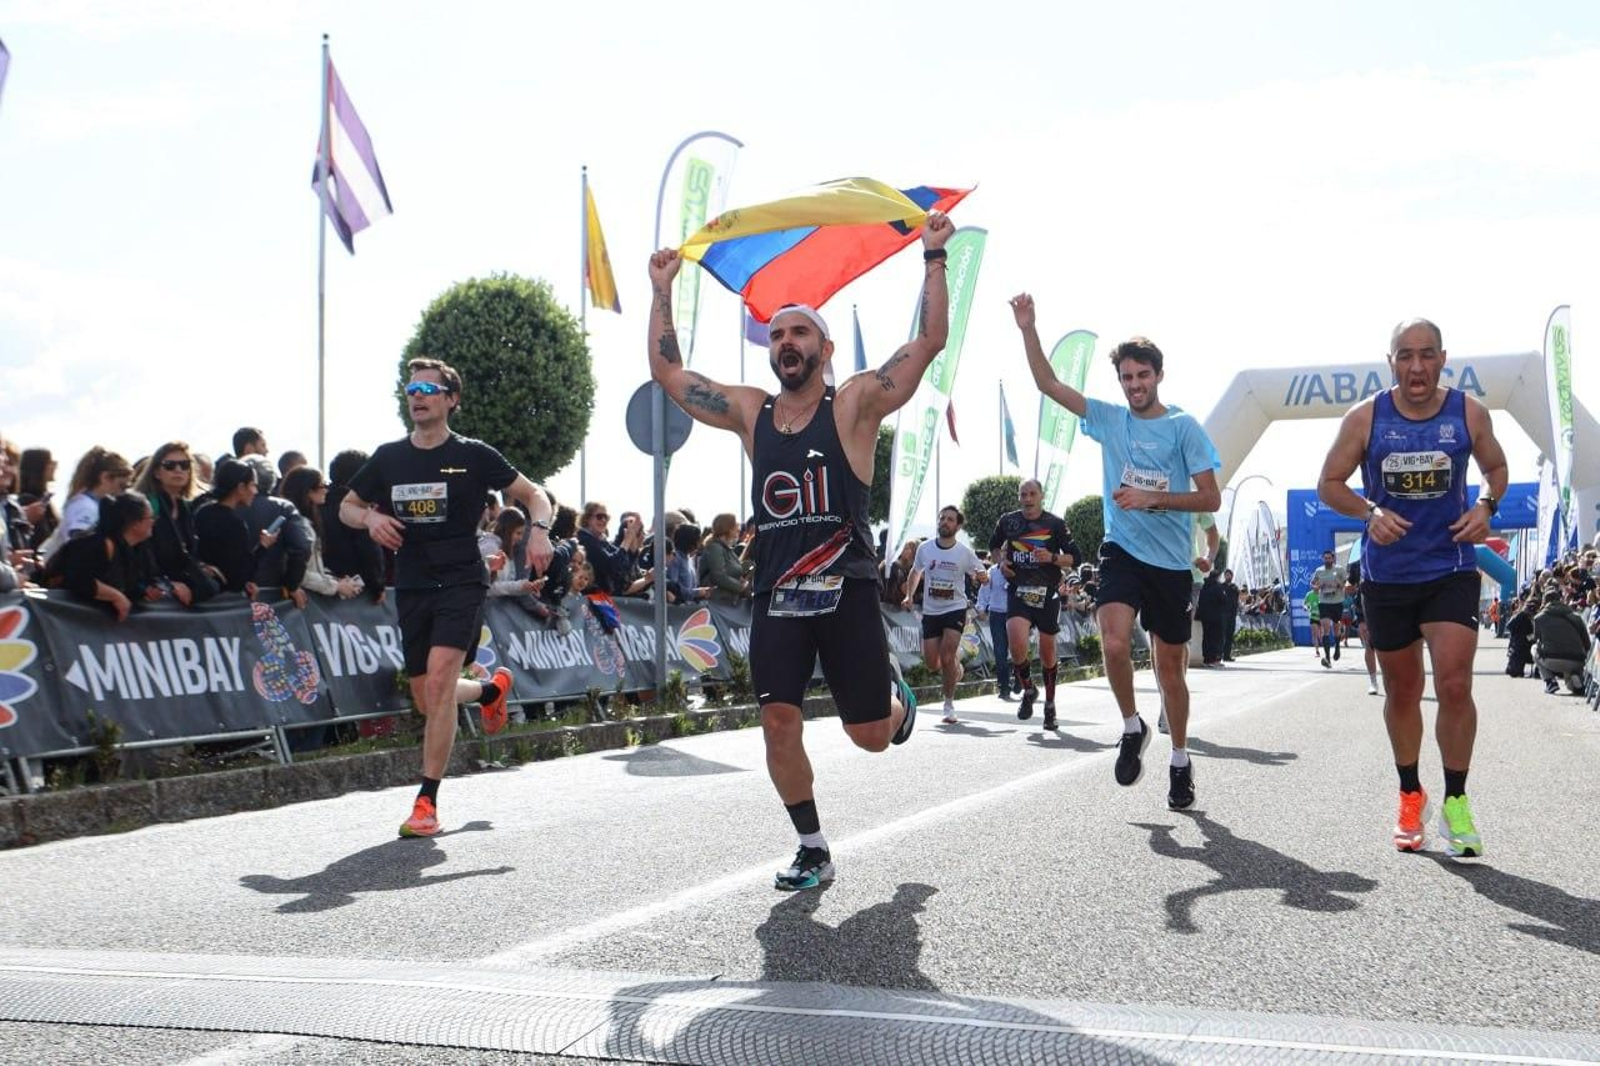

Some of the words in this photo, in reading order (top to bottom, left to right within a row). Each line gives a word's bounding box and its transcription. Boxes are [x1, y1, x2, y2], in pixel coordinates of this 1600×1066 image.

[1402, 471, 1436, 489] 314
[407, 499, 436, 514] 408
[758, 518, 798, 532] SERVICIO
[509, 628, 594, 670] MINIBAY
[79, 636, 246, 701] MINIBAY
